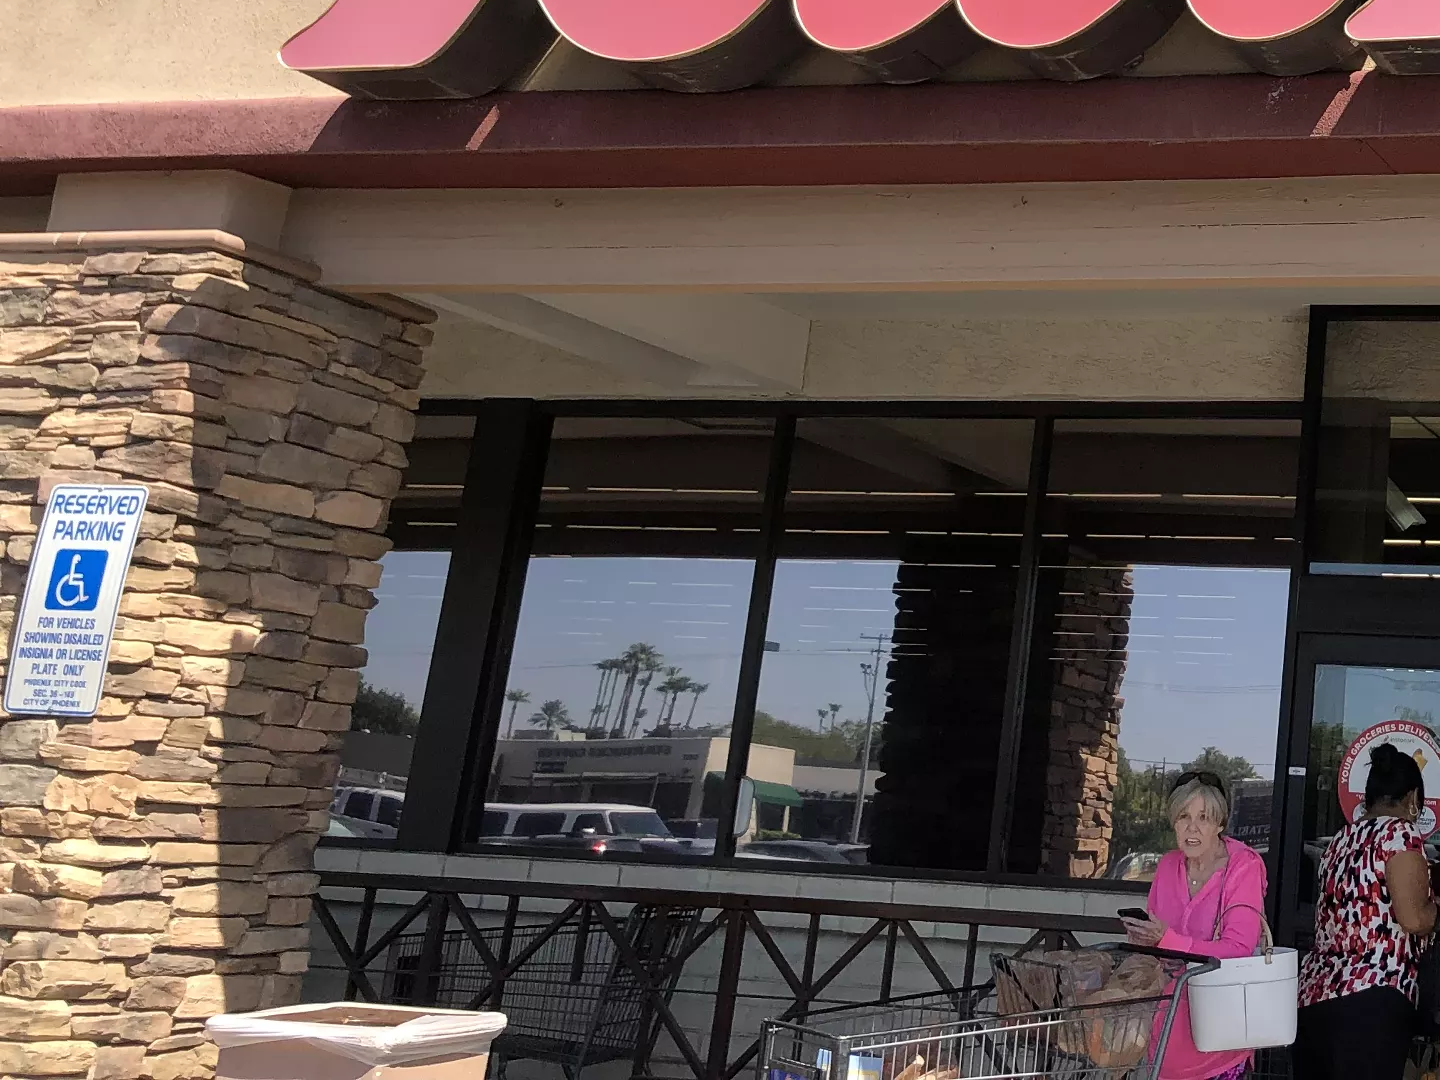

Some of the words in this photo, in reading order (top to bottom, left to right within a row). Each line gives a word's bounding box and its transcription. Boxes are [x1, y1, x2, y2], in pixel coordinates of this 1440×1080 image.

[52, 494, 140, 516] RESERVED
[52, 519, 126, 542] PARKING
[37, 616, 55, 629] FOR
[56, 617, 97, 630] VEHICLES
[23, 631, 63, 644] SHOWING
[63, 633, 105, 646] DISABLED
[18, 646, 54, 660] INSIGNIA
[55, 648, 68, 660] OR
[68, 649, 103, 662] LICENSE
[30, 662, 58, 676] PLATE
[62, 663, 85, 677] ONLY
[23, 678, 52, 687] PHOENIX
[53, 680, 70, 688] CITY
[22, 698, 40, 706] CITY
[39, 698, 50, 707] OF
[51, 699, 82, 708] PHOENIX
[1341, 759, 1354, 785] YOUR
[1350, 723, 1397, 756] GROCERIES
